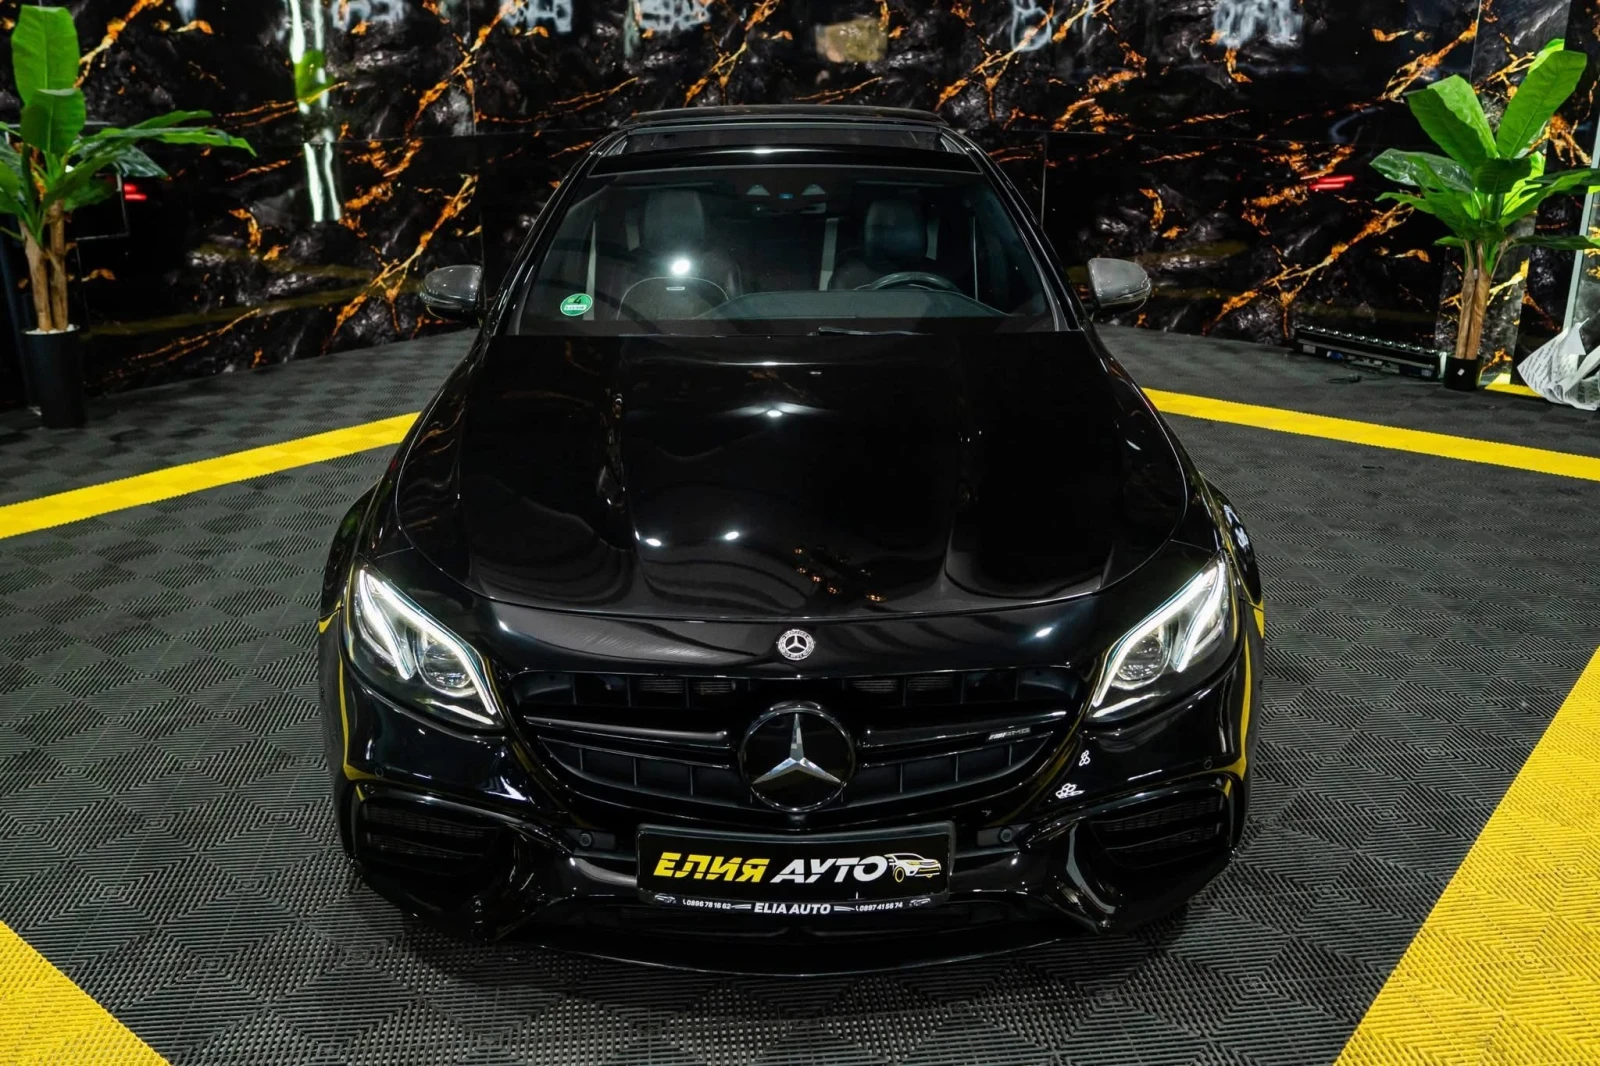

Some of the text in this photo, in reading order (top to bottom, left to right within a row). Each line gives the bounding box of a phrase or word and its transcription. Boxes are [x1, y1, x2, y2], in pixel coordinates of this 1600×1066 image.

[573, 295, 582, 305] 4
[653, 851, 889, 884] ЕЛИЯ АУТО
[754, 902, 831, 915] ELIA AUTO
